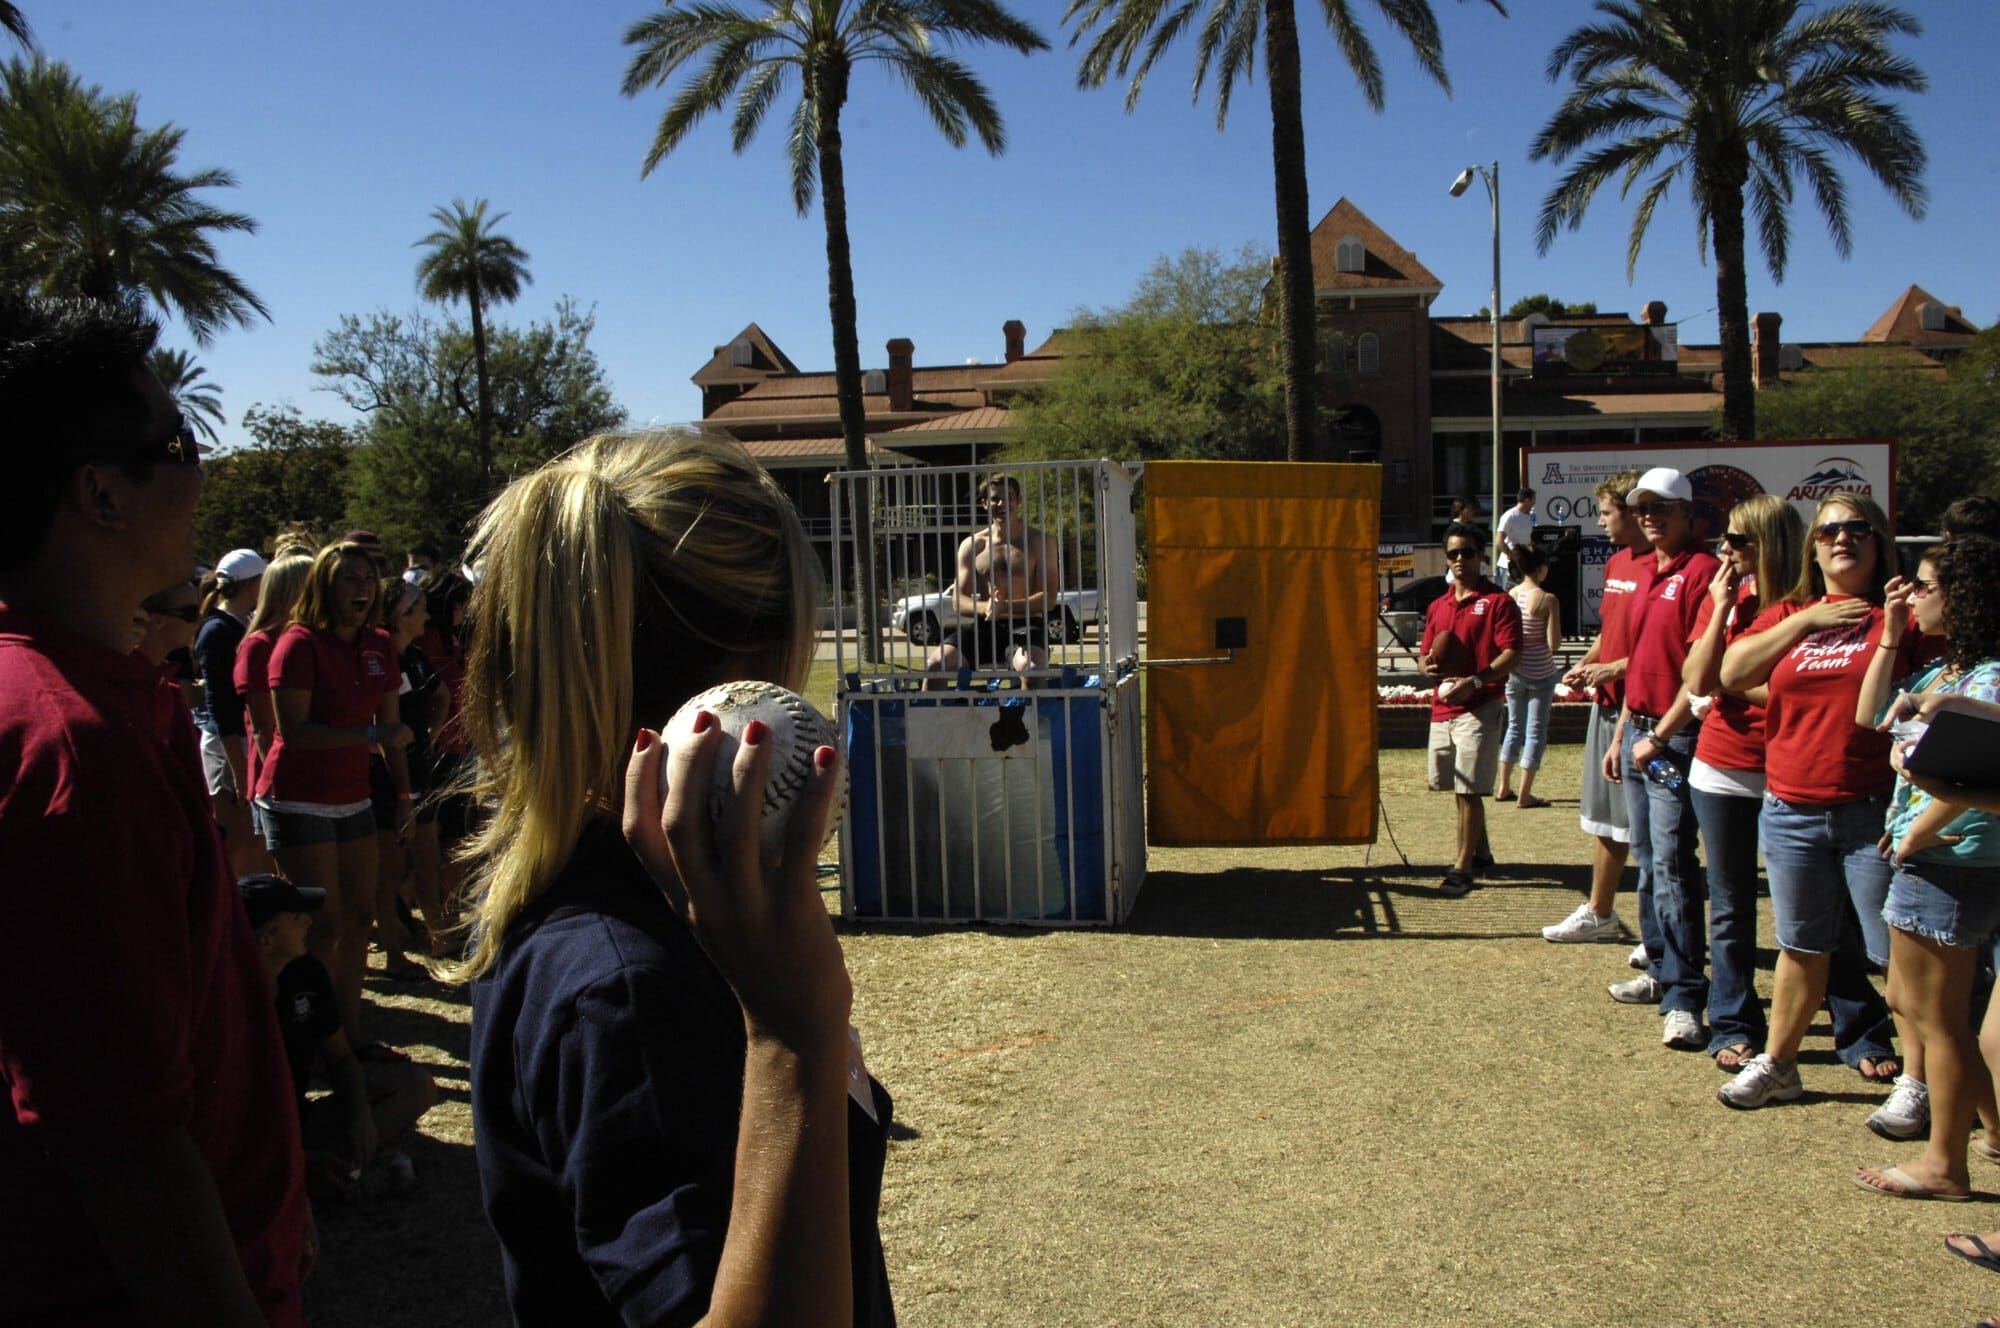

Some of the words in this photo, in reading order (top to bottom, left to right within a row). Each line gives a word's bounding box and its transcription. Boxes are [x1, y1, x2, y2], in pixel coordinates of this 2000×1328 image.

[1394, 543, 1414, 554] OPEN
[1791, 640, 1869, 659] Fridays
[1796, 656, 1852, 672] Team
